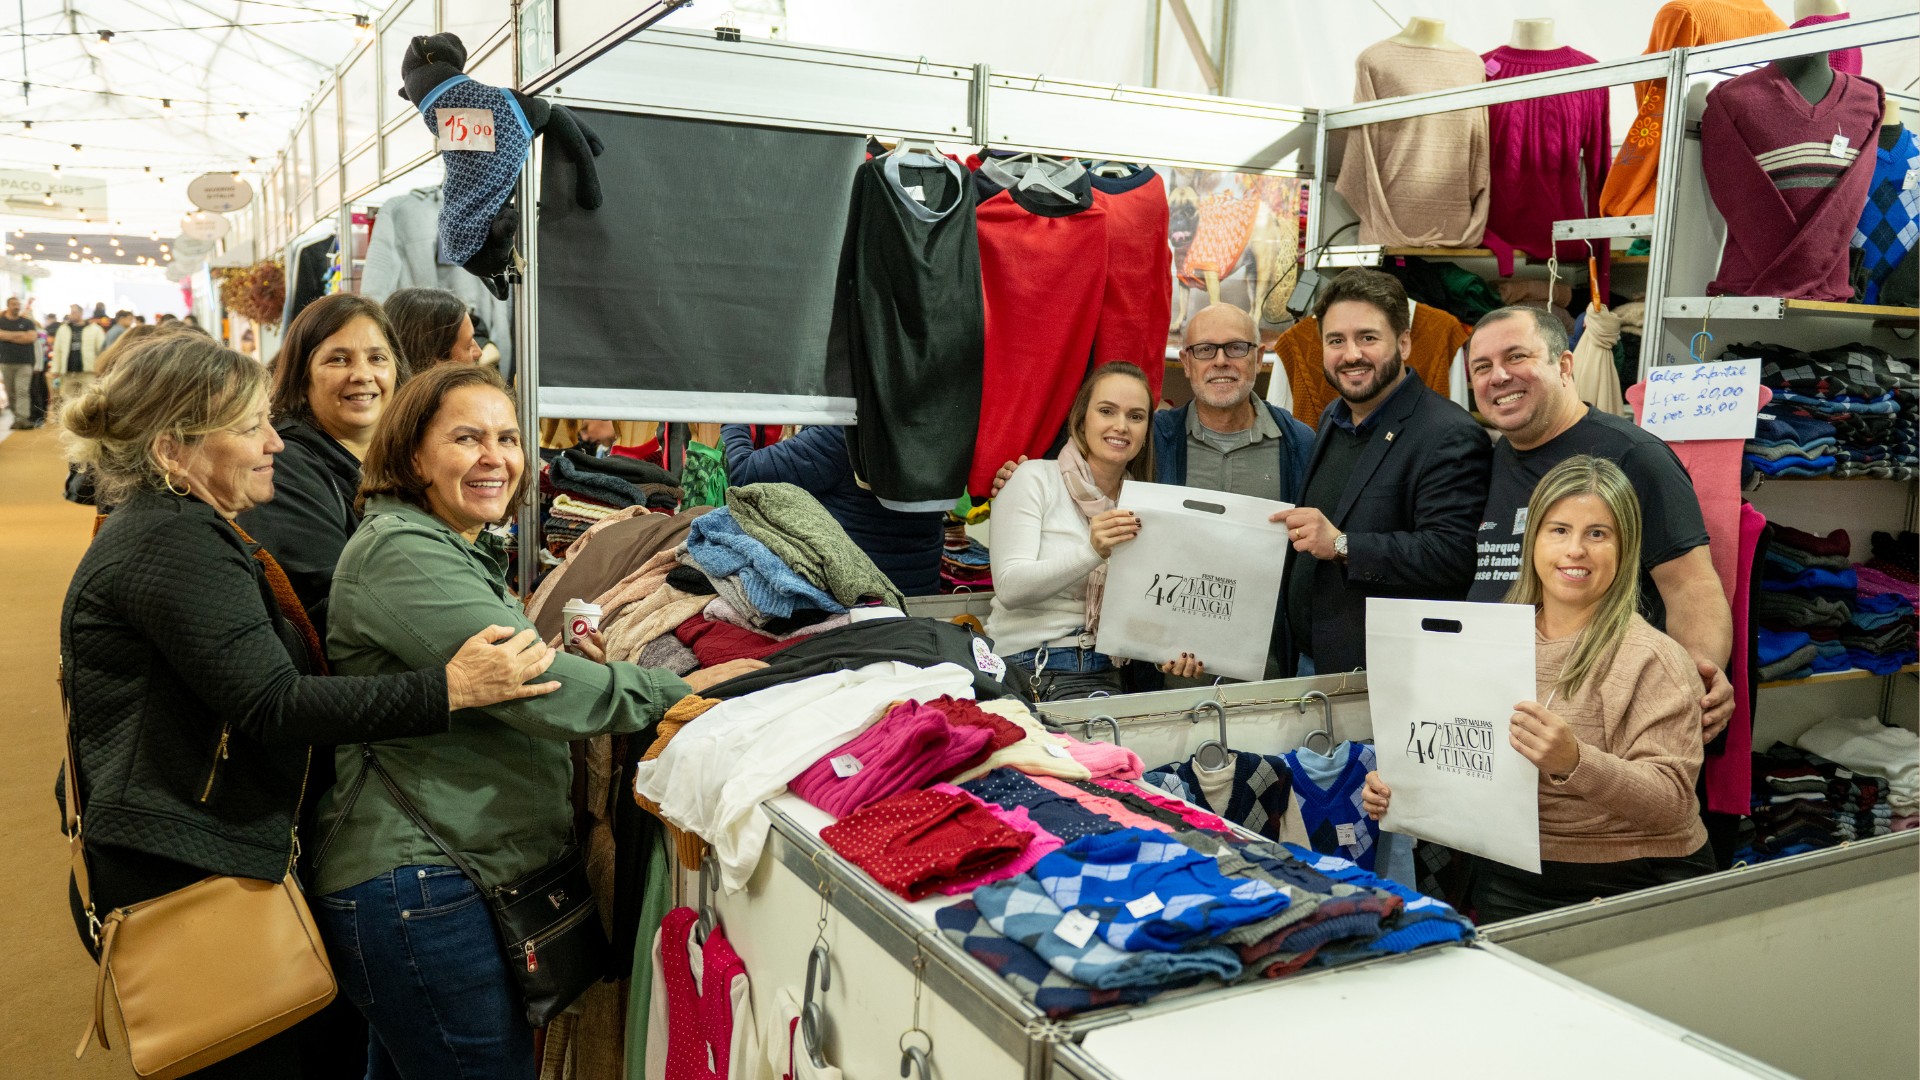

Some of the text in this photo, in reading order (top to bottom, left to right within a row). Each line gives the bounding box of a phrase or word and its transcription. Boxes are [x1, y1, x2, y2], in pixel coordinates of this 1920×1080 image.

[444, 115, 492, 145] 15,00
[1649, 392, 1660, 406] 1
[1697, 386, 1744, 400] 20,00
[1646, 412, 1657, 425] 2
[1201, 573, 1215, 581] FEST
[1188, 578, 1234, 600] JACU
[1172, 607, 1231, 621] MINAS GERAIS
[1180, 595, 1230, 615] TINGA
[1454, 717, 1493, 728] FEST MALHAS
[1444, 724, 1492, 751] JACU
[1440, 748, 1492, 773] TINGA
[1436, 765, 1493, 781] MINAS GERAIS
